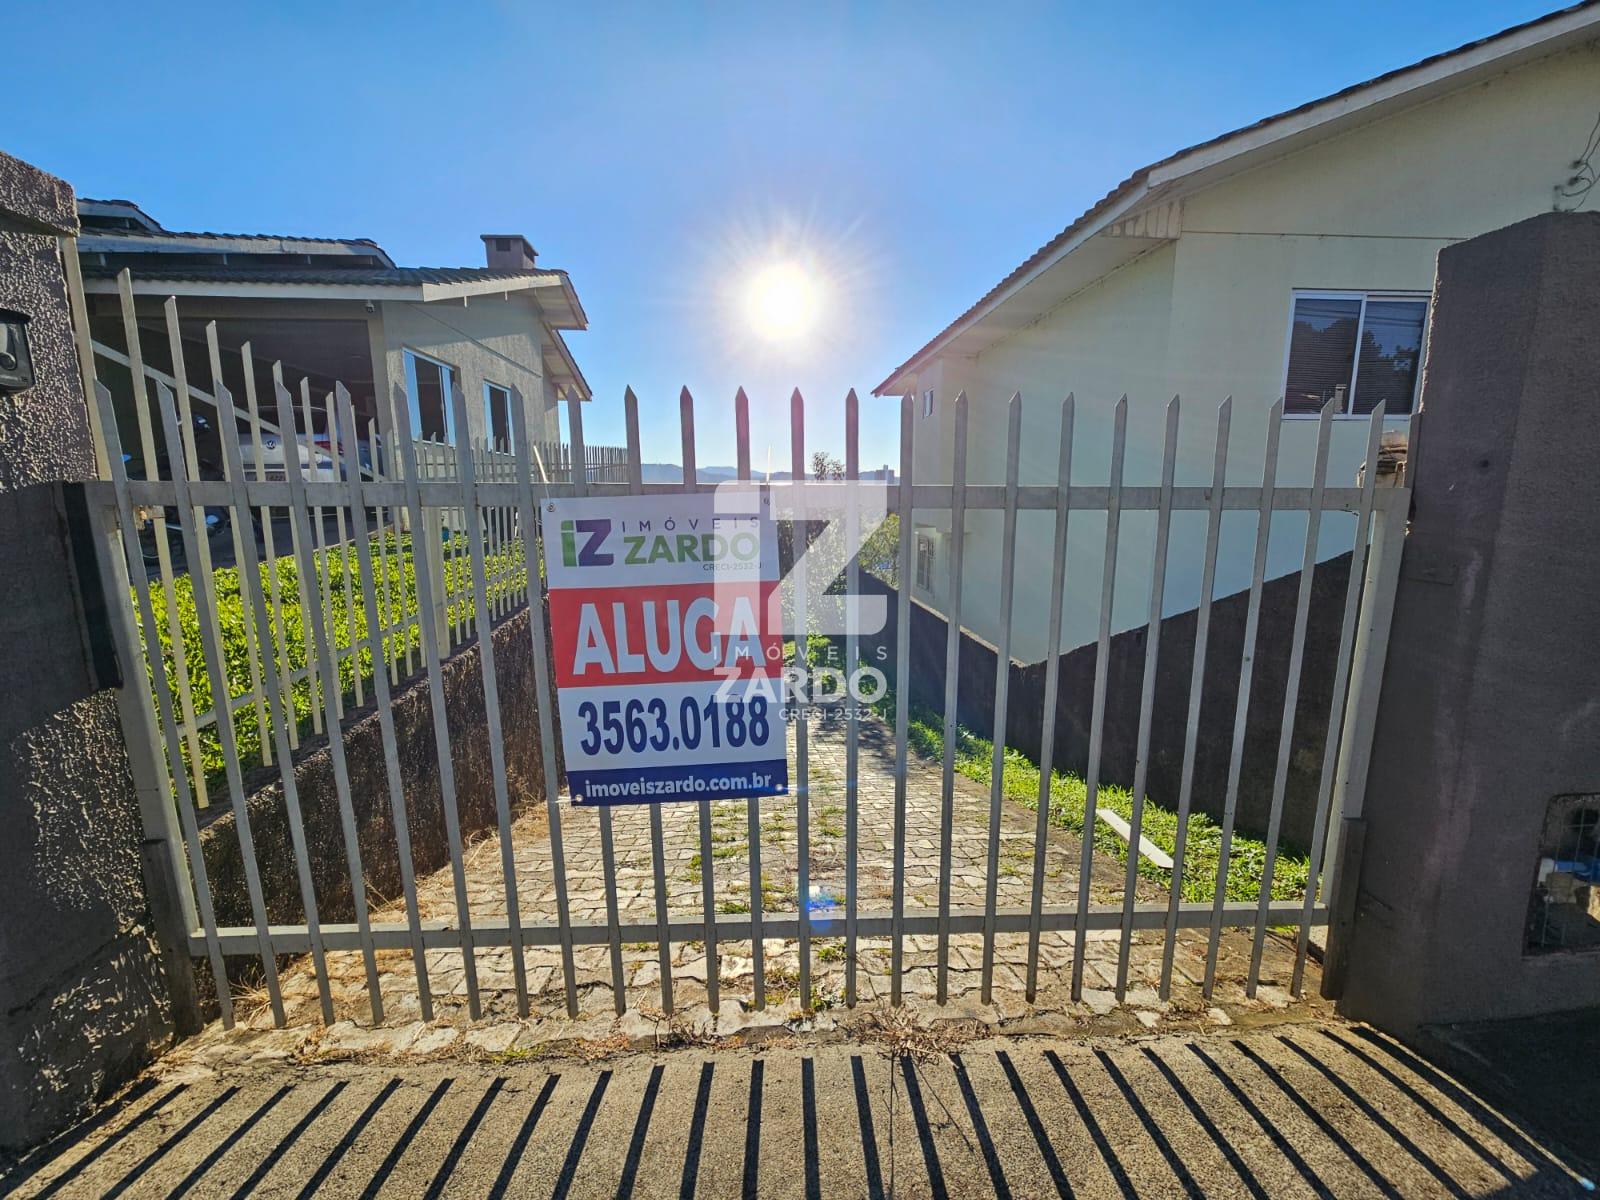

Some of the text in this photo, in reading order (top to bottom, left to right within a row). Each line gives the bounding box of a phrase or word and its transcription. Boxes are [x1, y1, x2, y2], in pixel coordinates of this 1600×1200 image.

[621, 516, 759, 532] IMÓVEIS
[623, 532, 760, 564] ZARDO
[573, 597, 767, 675] ALUGA
[578, 694, 769, 756] 3563.0188
[585, 772, 772, 798] imoveiszardo.com.br
